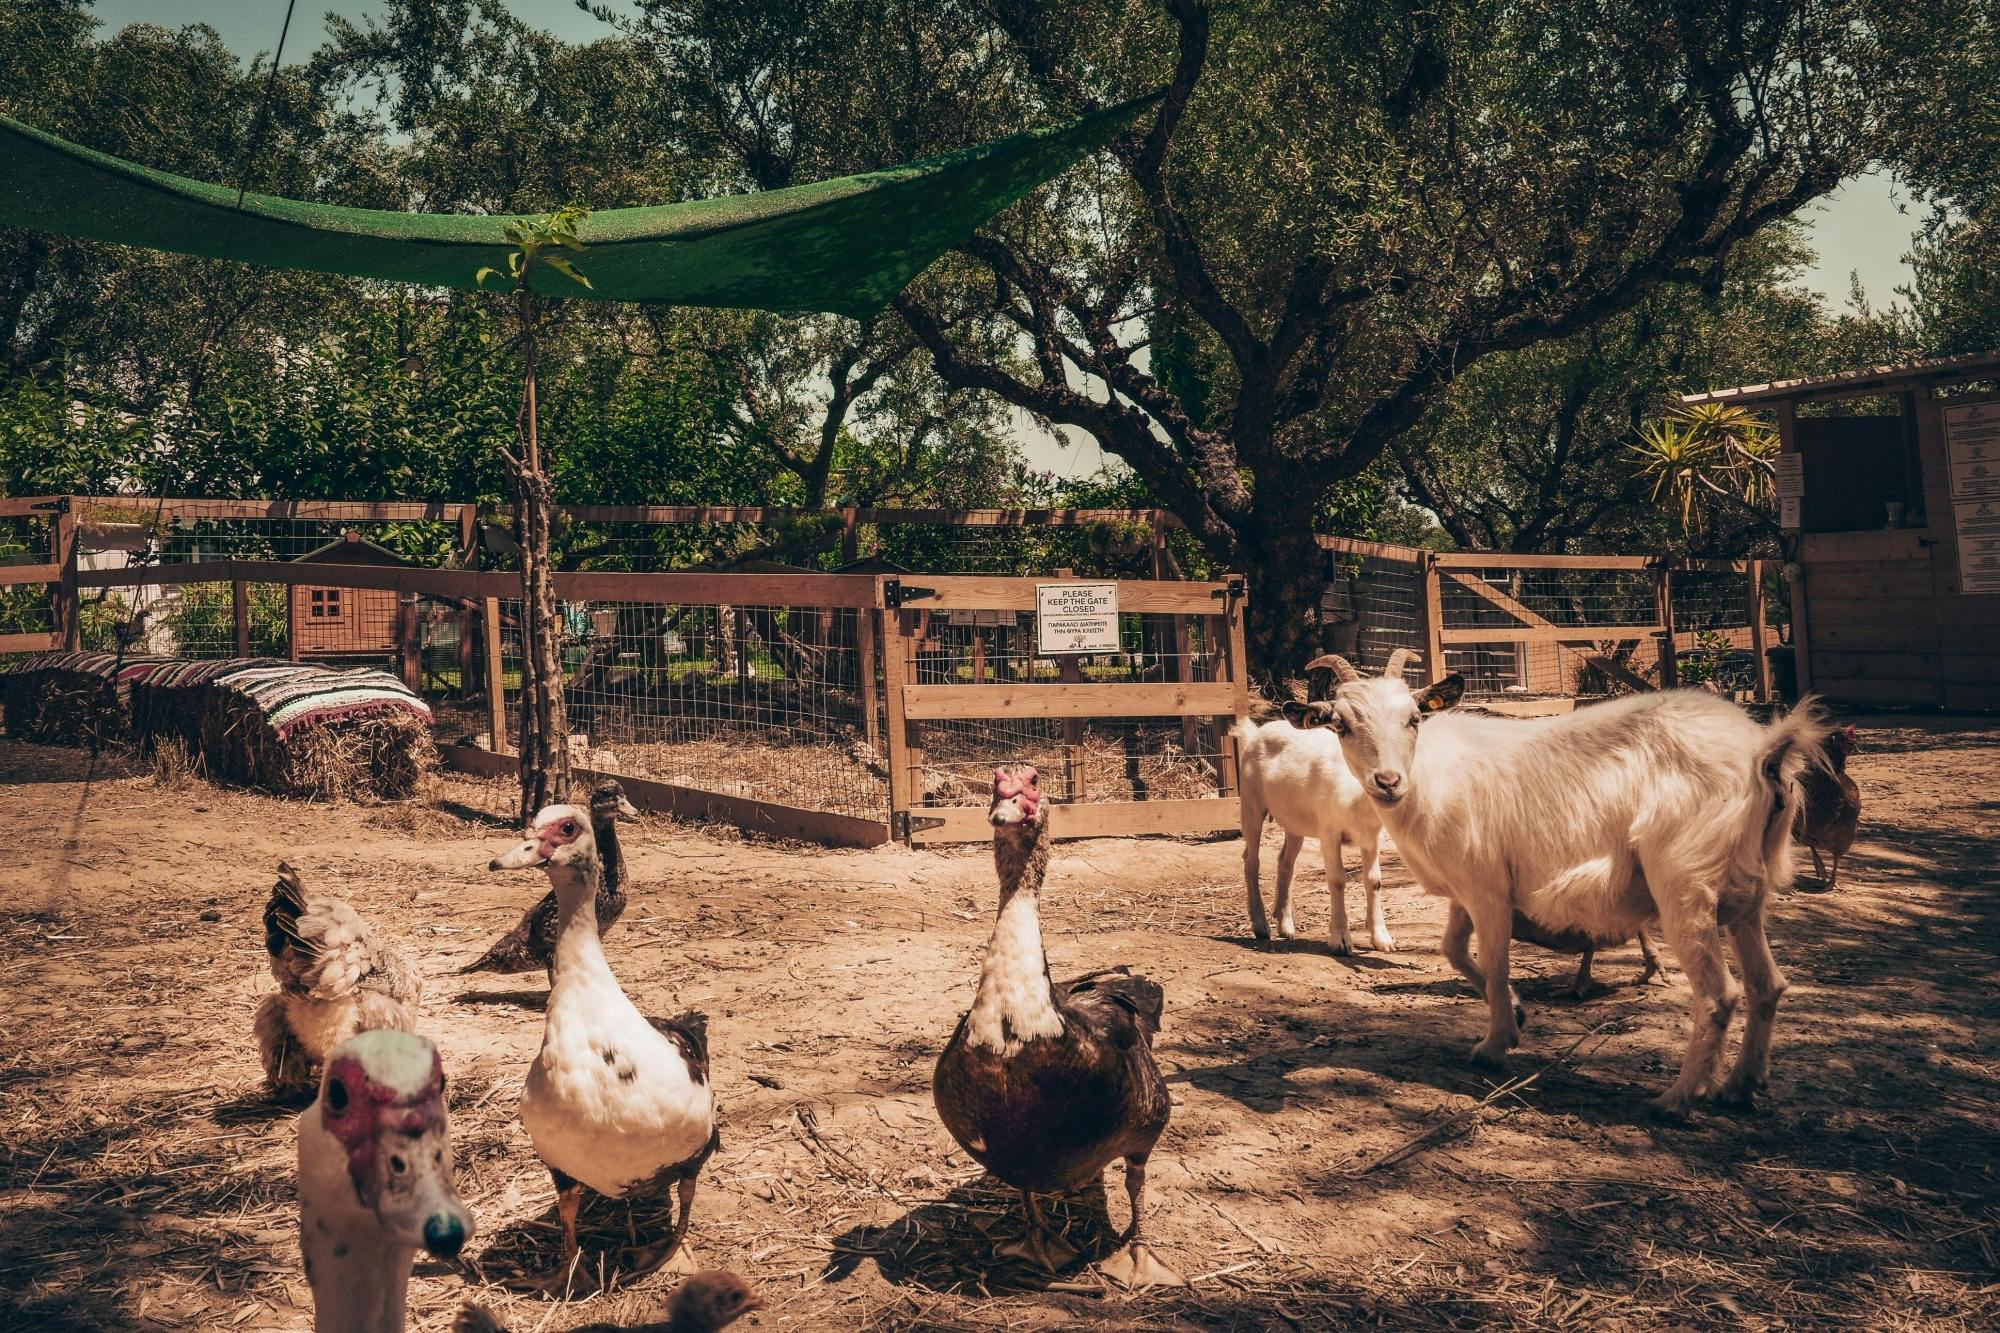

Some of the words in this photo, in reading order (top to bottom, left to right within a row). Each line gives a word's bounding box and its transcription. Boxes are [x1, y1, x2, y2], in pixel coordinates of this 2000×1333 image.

[1062, 590, 1093, 598] PLEASE
[1047, 598, 1069, 606] KEEP
[1087, 597, 1108, 605] GATE
[1062, 605, 1096, 613] CLOSED
